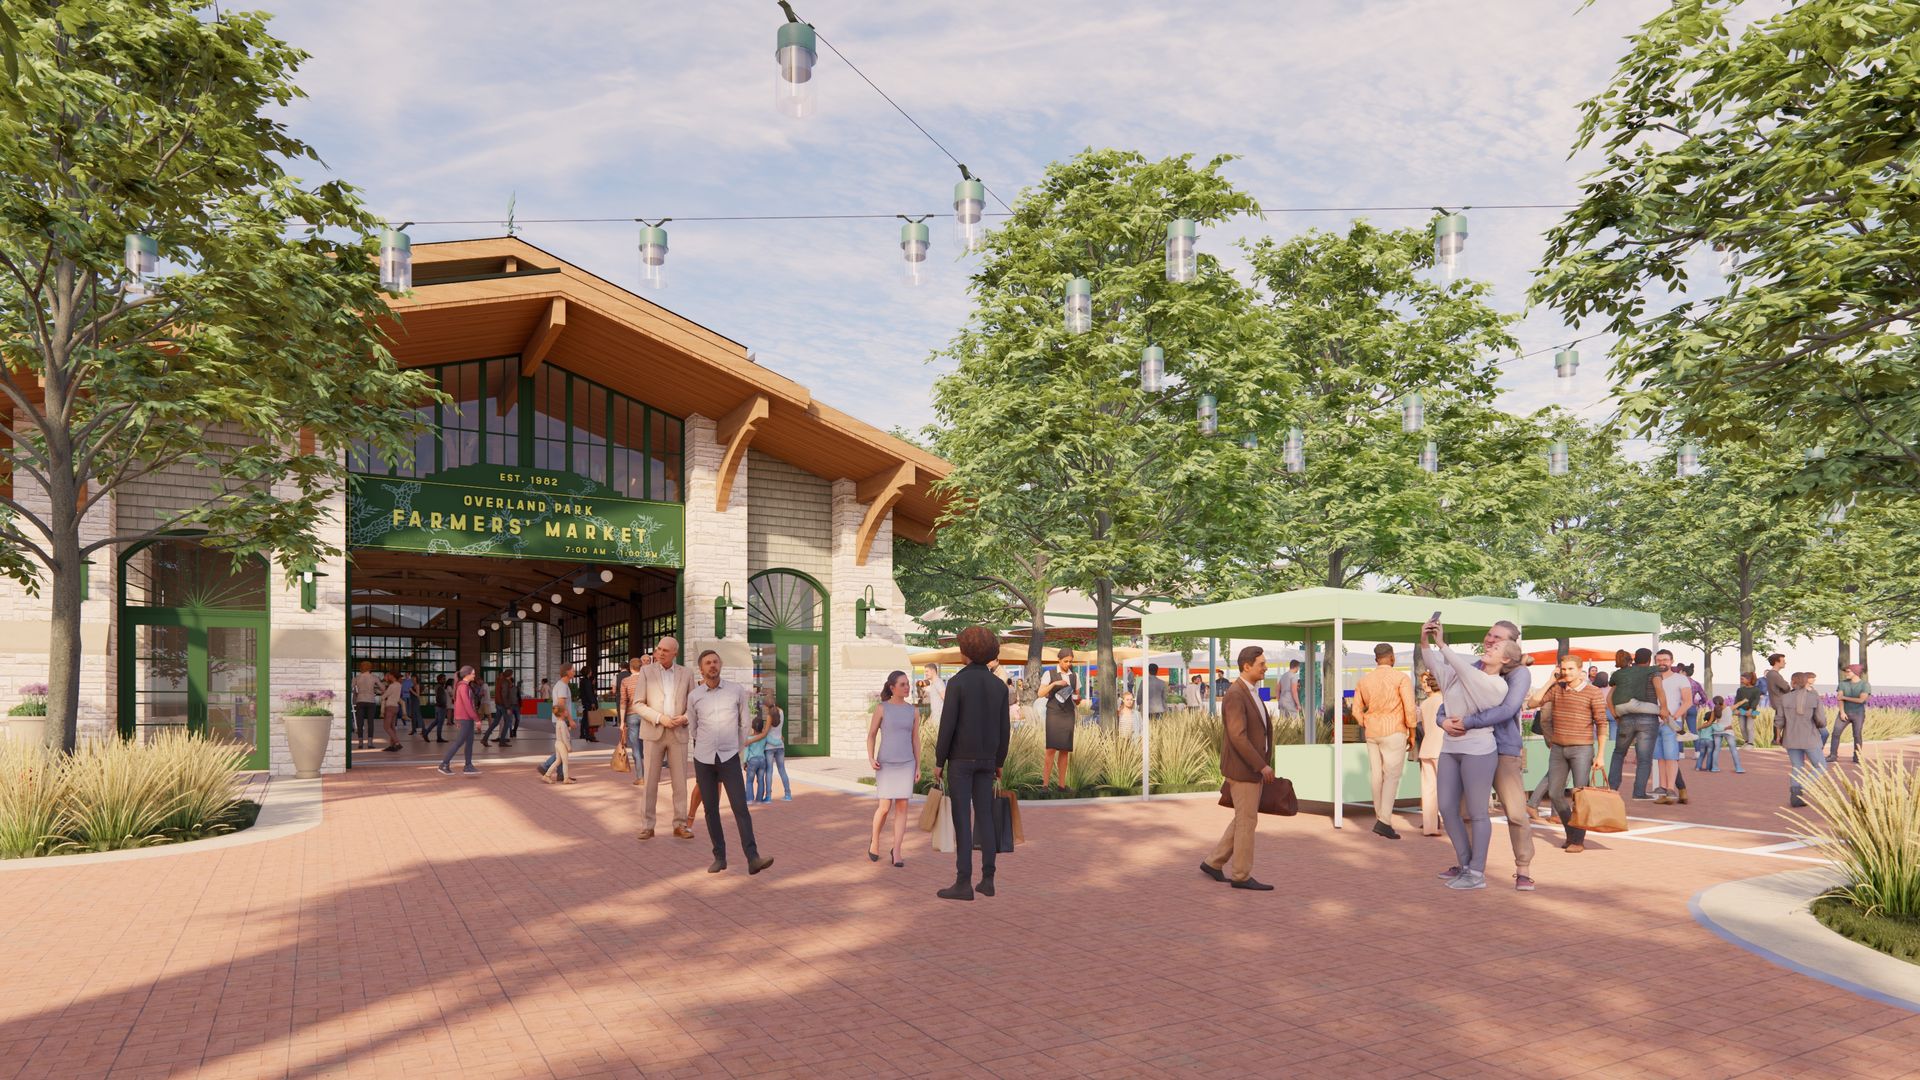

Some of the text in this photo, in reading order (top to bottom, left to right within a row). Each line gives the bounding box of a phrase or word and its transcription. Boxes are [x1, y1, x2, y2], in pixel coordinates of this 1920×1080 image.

[499, 473, 558, 486] EST. 1982
[463, 495, 593, 516] OVERLAND PARK
[392, 509, 647, 544] FARMERS' MARKET
[620, 549, 641, 557] 1:00
